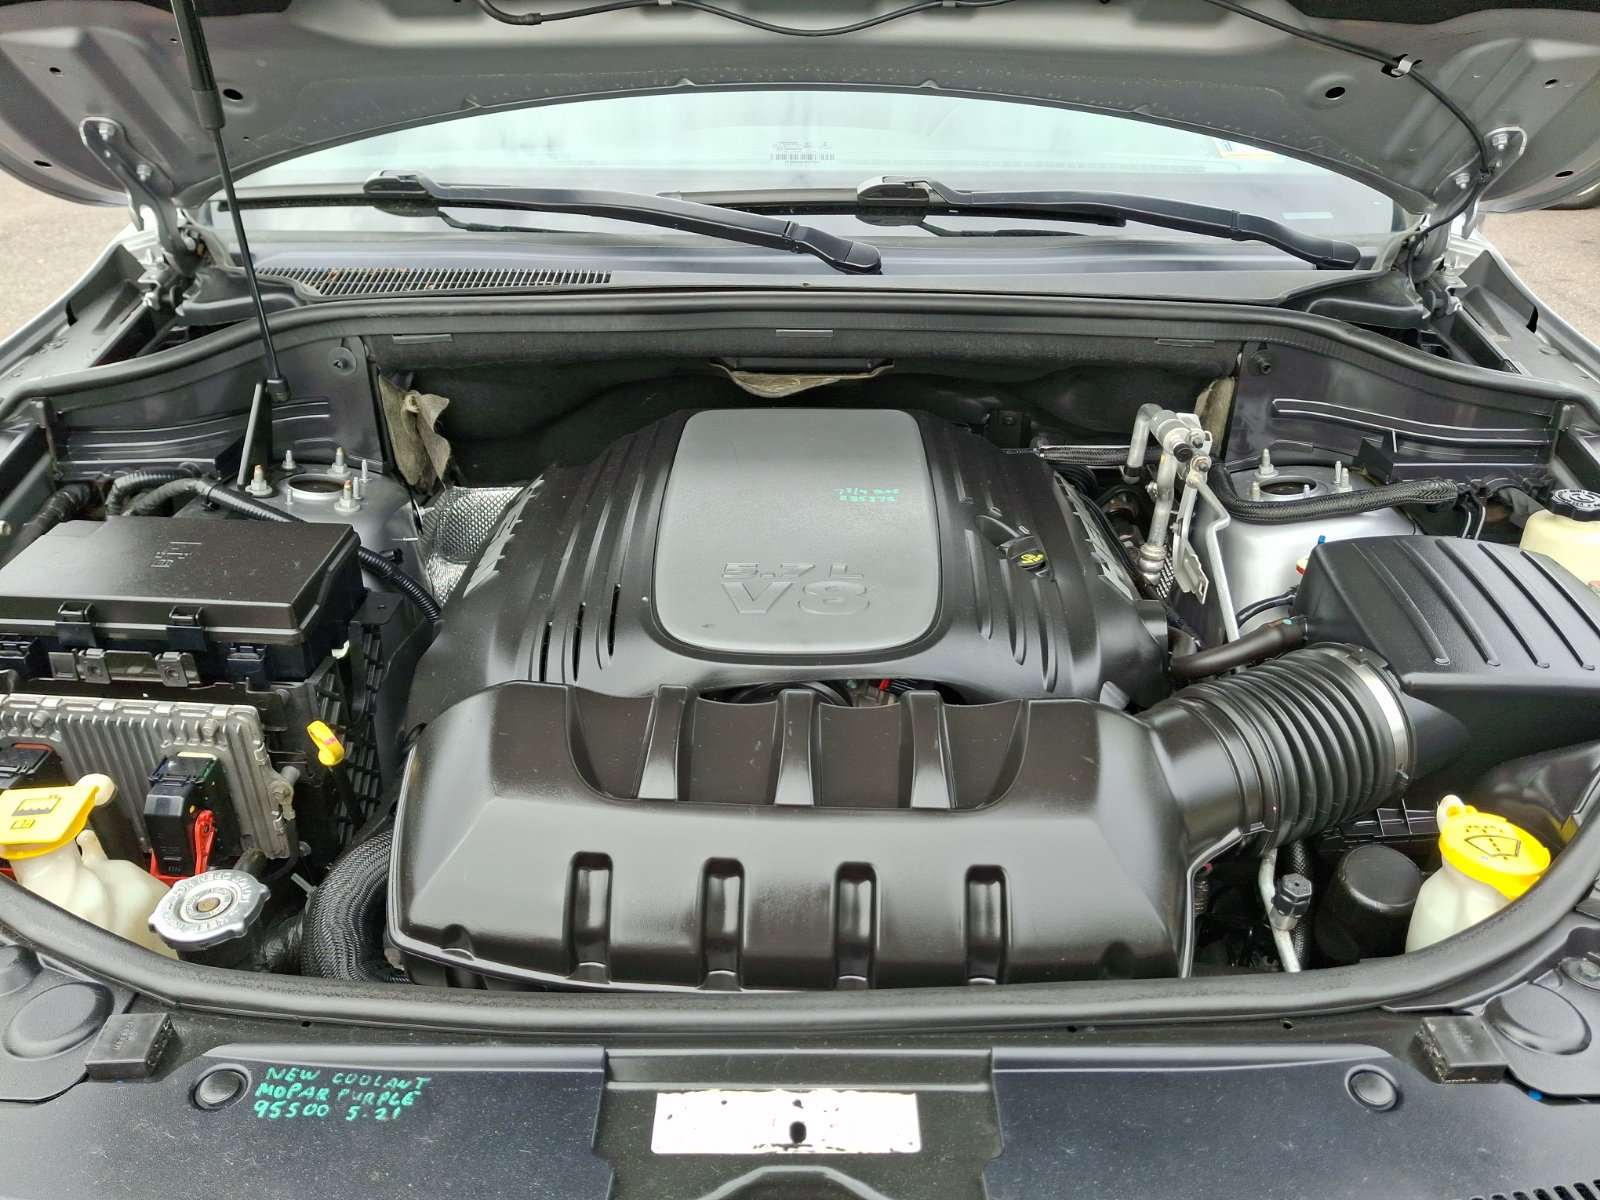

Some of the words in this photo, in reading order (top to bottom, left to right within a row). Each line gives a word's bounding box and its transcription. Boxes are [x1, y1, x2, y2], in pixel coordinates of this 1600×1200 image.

[720, 581, 870, 615] V8
[265, 1067, 321, 1082] NEW
[332, 1072, 432, 1091] COOLANT
[255, 1082, 330, 1101] MOPAR
[337, 1087, 422, 1107] PURPLE
[253, 1099, 330, 1119] 95500
